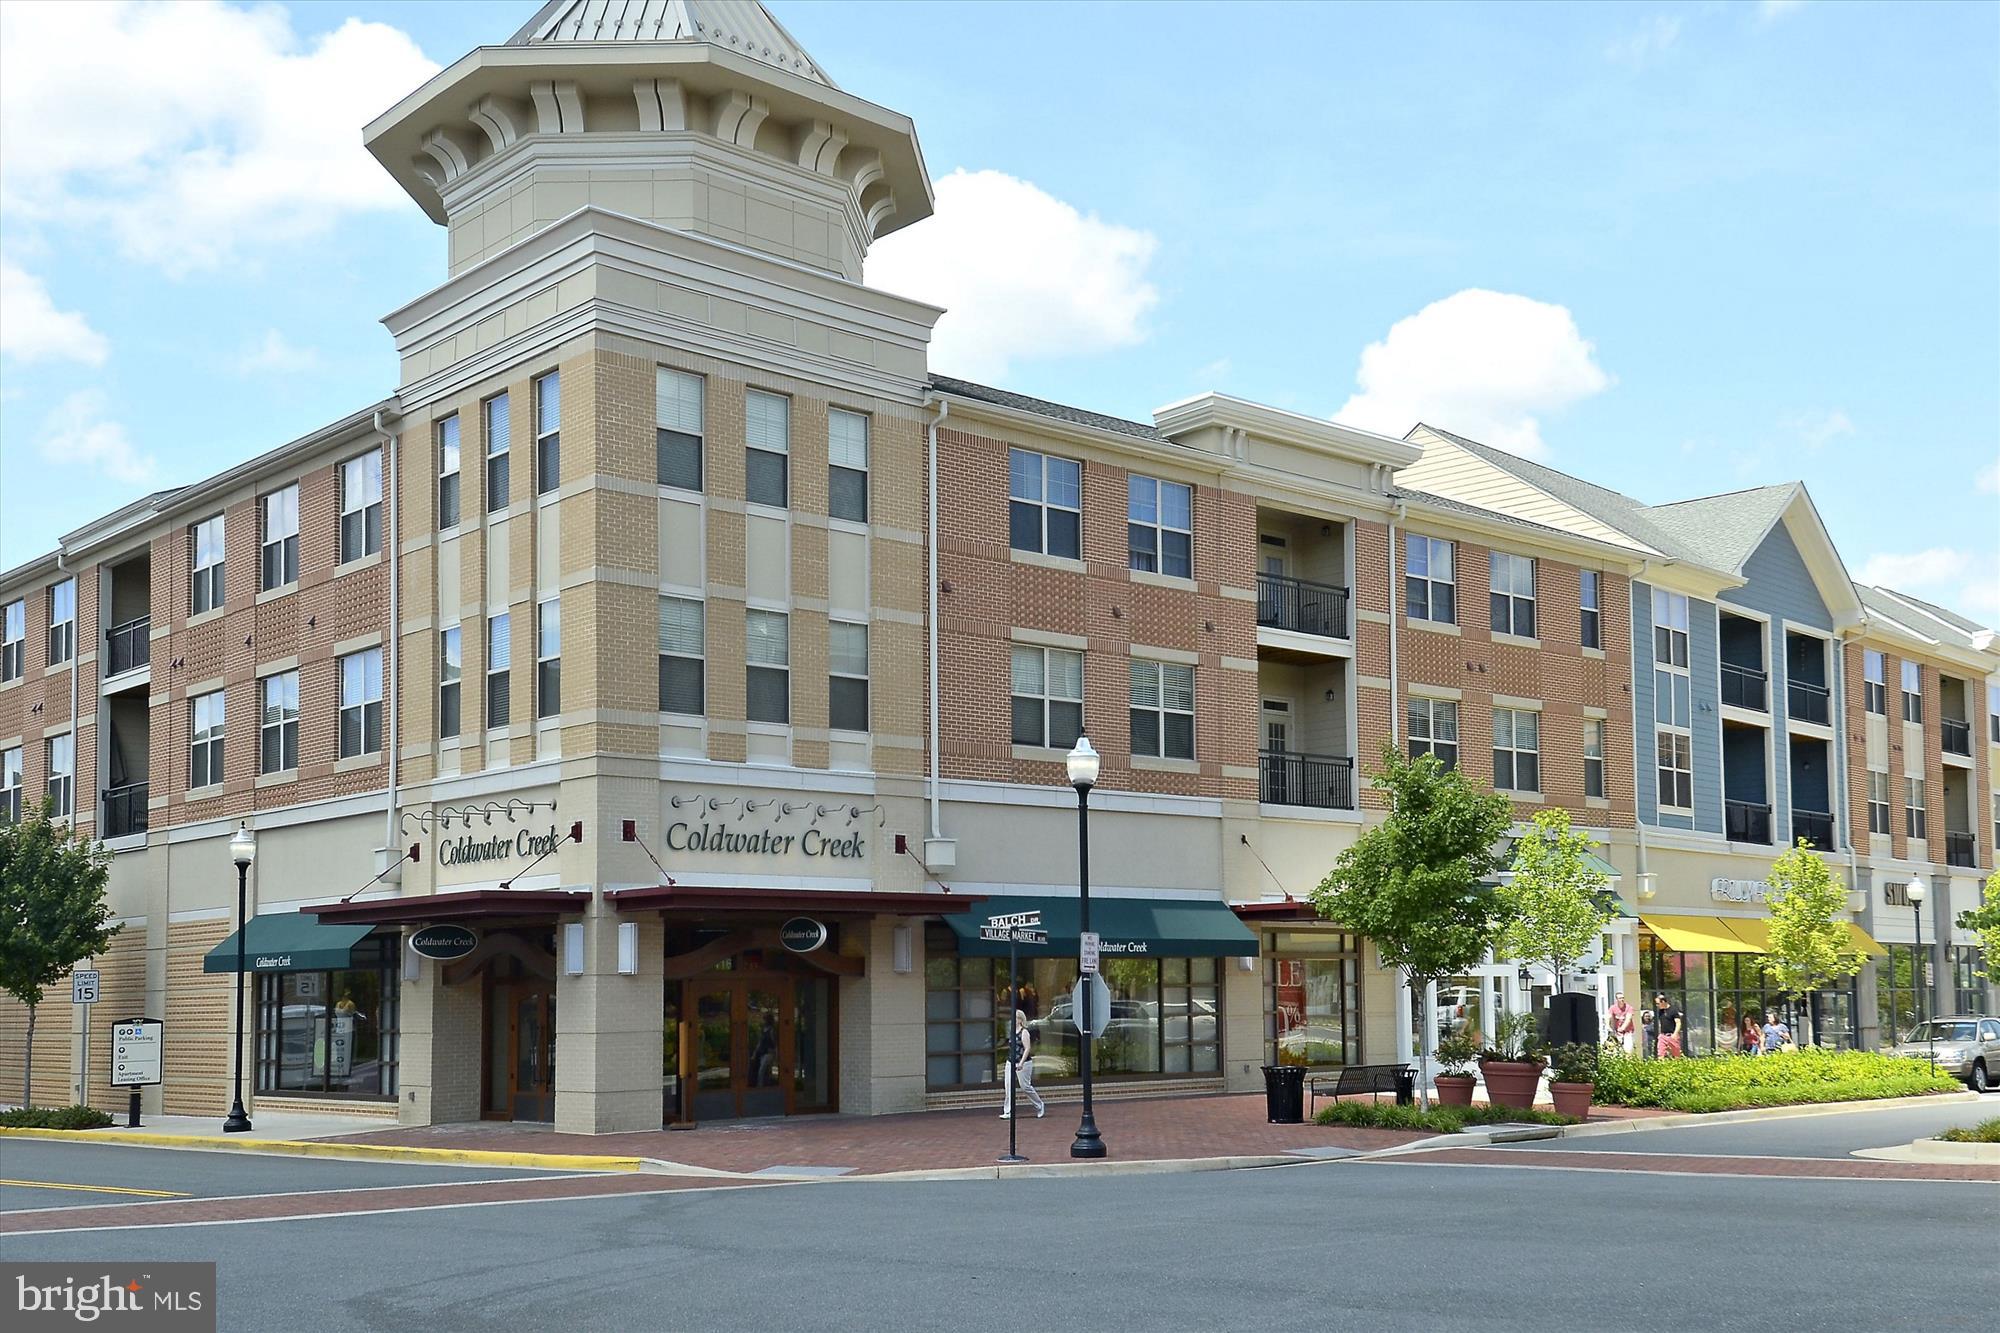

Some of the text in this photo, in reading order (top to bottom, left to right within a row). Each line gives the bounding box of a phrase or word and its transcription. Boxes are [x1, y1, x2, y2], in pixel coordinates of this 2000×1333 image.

[439, 825, 559, 866] Coldwater Creek
[666, 822, 865, 858] Coldwater Creek
[991, 914, 1026, 928] BALCH
[985, 928, 1010, 940] VILLAGE
[1012, 930, 1036, 941] MARKET
[415, 937, 474, 947] Coldwater Creek
[1098, 941, 1148, 952] oldwater Creek
[77, 987, 94, 1000] 15
